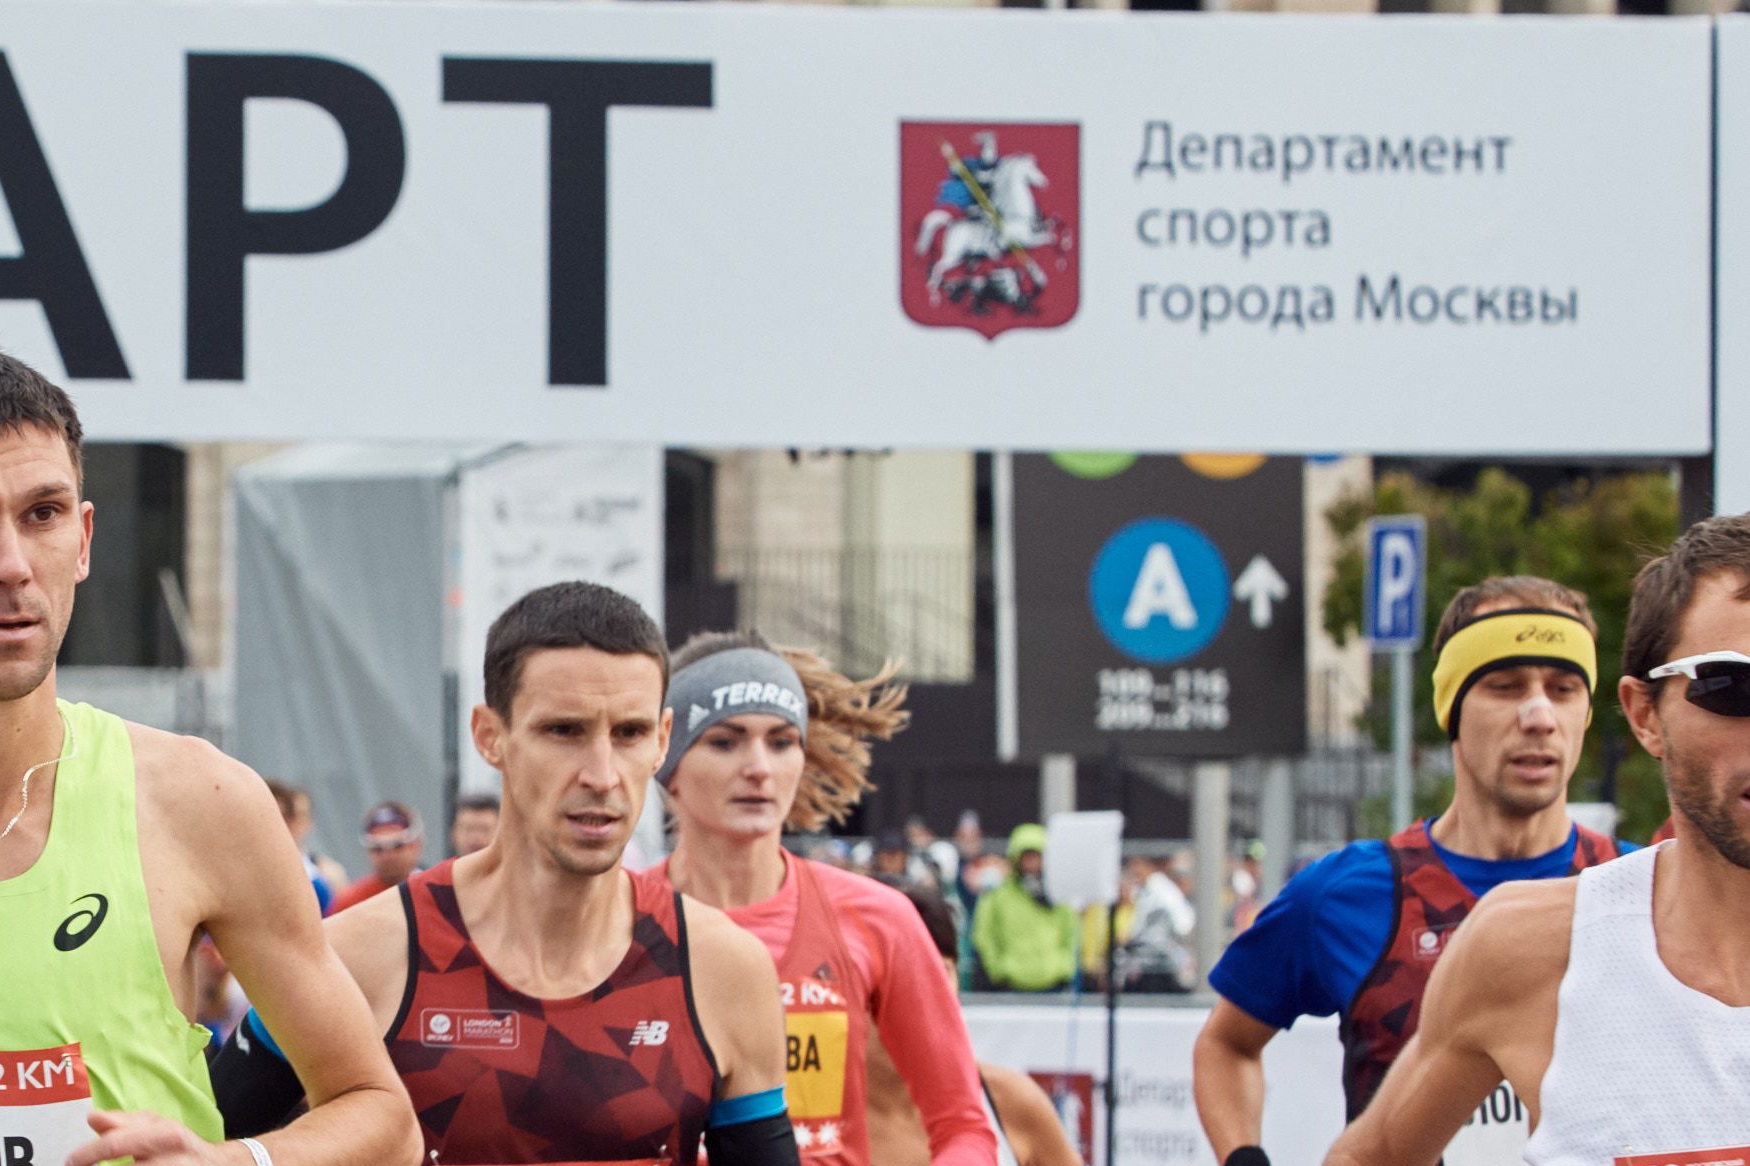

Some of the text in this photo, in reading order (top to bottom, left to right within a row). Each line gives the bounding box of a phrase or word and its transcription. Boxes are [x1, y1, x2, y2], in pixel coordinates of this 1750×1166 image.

[1135, 120, 1513, 182] Департамент
[1136, 203, 1332, 254] спорта
[1137, 274, 1579, 334] города Москвы
[1122, 541, 1200, 630] A
[1379, 533, 1416, 632] P
[712, 680, 803, 719] TERREX
[16, 1058, 75, 1091] КМ
